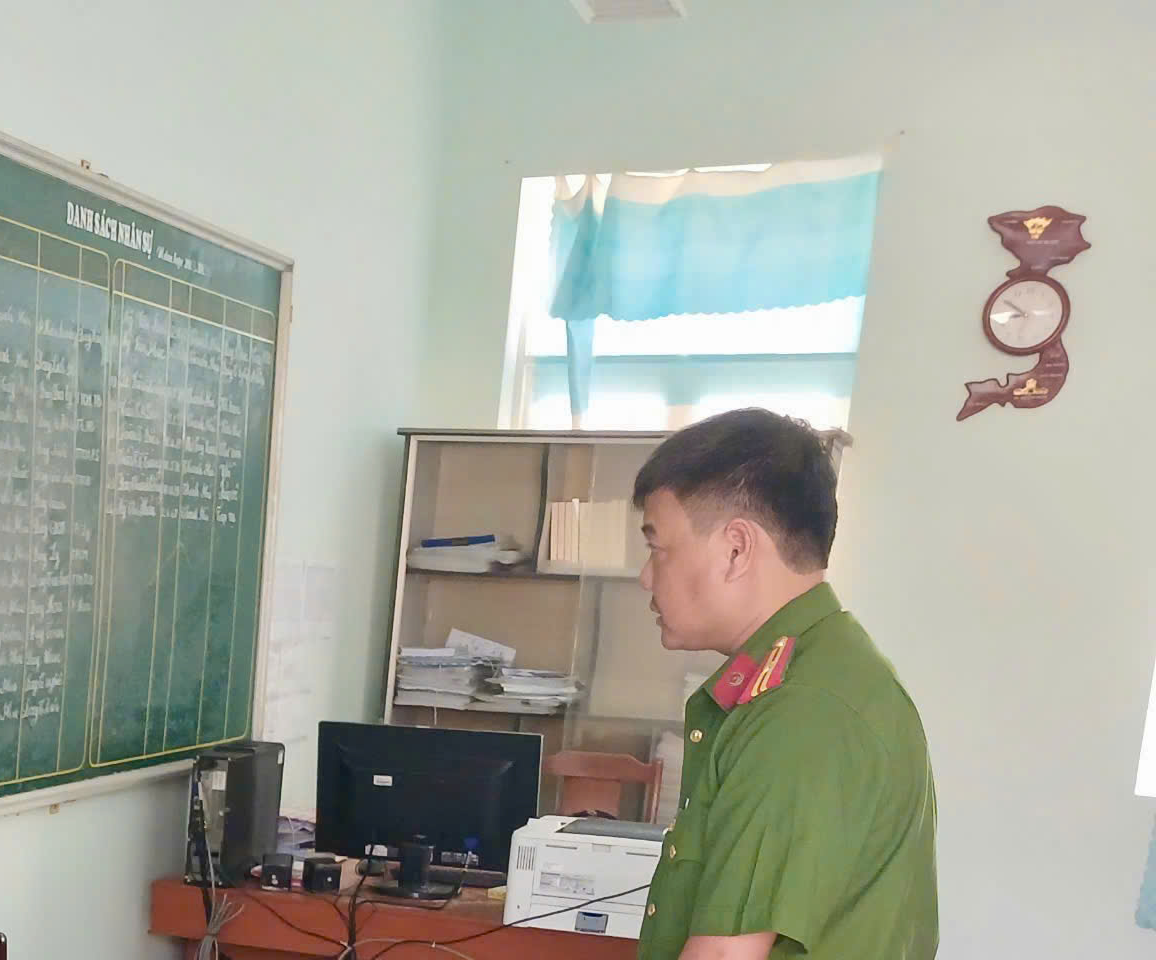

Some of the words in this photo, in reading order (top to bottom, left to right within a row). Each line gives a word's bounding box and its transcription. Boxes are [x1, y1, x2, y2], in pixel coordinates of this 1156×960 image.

[66, 201, 94, 232] DANH
[94, 208, 118, 242] SÁCH
[117, 222, 142, 251] NHÂN
[142, 229, 154, 260] SỰ
